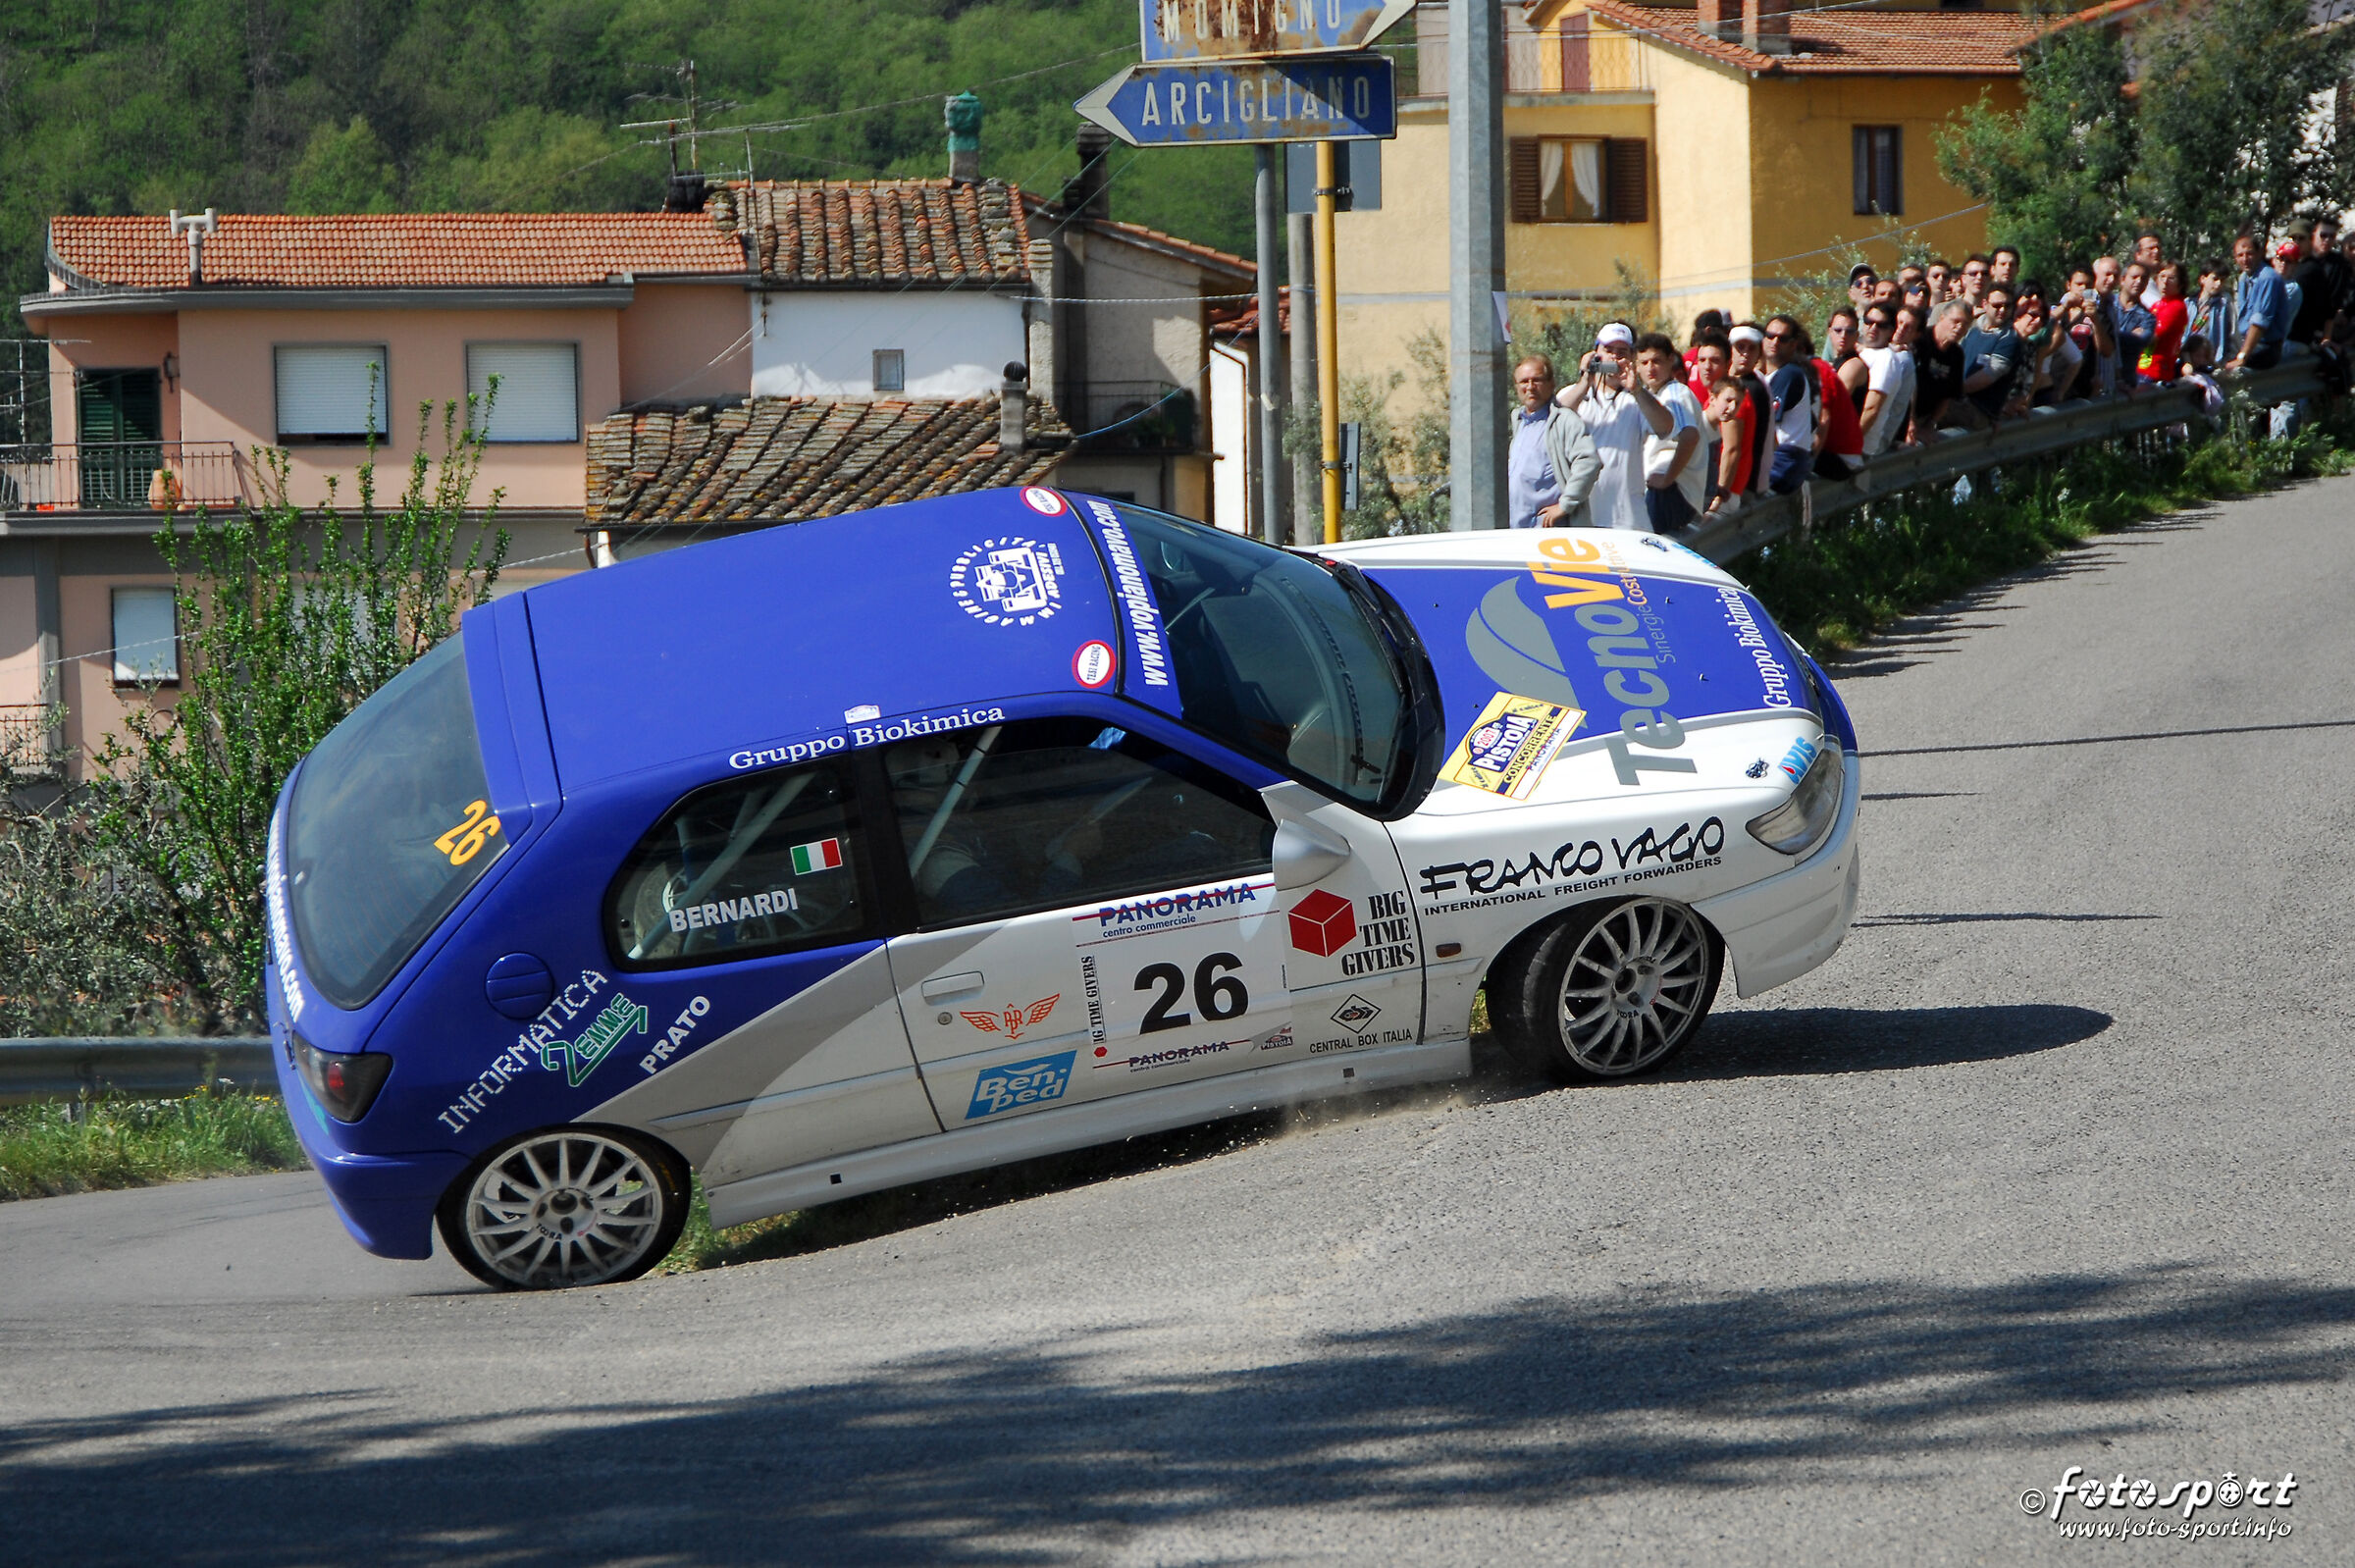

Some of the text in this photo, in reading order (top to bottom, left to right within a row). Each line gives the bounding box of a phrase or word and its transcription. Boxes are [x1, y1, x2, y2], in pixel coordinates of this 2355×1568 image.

[1141, 76, 1371, 127] ARCIGLIANO
[1035, 551, 1061, 599] ADESIVI
[1526, 537, 1699, 786] TecnoVie
[1715, 587, 1793, 708] Gruppo Biokimica
[728, 732, 846, 770] Gruppo
[853, 706, 1006, 749] Biokimica
[1472, 715, 1535, 771] PISTOIA
[1477, 729, 1497, 747] 2007
[1503, 714, 1558, 784] CONCORRENTE
[1526, 727, 1562, 772] PANORAMA
[433, 799, 501, 866] 26
[1419, 815, 1725, 900] FRANCO VAGO
[668, 887, 799, 933] BERNARDI
[1098, 882, 1257, 927] PANORAMA
[1368, 889, 1407, 920] BIG
[1424, 856, 1723, 916] INTERNATIONAL FREIGHT FORWARDERS
[1102, 915, 1197, 939] centro commerciale
[1358, 916, 1412, 948] TIME
[1080, 955, 1099, 999] GIVERS
[1340, 942, 1416, 976] GIVERS
[1087, 999, 1103, 1028] TIME
[1133, 951, 1249, 1036] 26
[438, 968, 608, 1134] INFORMATICA
[639, 995, 711, 1075] PRATO
[1128, 1040, 1230, 1068] PANORAMA
[1309, 1027, 1413, 1054] CENTRAL BOX ITALIA
